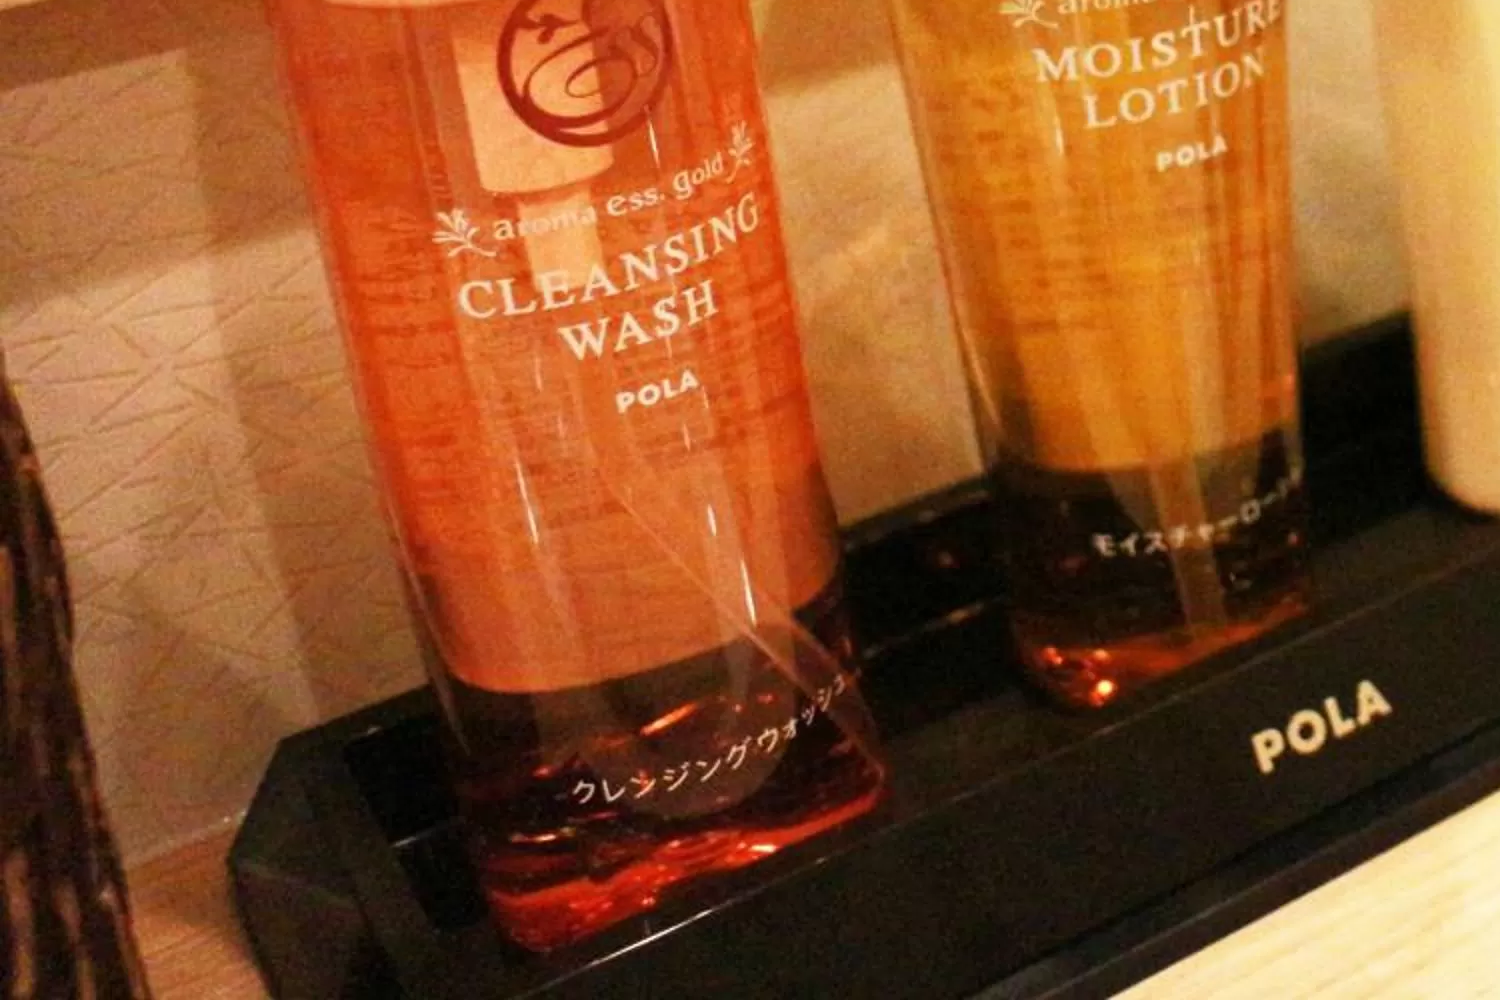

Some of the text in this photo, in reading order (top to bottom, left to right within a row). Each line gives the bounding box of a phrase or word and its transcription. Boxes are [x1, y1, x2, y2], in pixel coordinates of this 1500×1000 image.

[1082, 45, 1268, 129] LOTION
[1156, 134, 1228, 173] POLA
[493, 152, 724, 242] aroma ess. gold
[457, 191, 761, 320] CLEANSING
[557, 280, 719, 362] WASH
[615, 369, 700, 414] POLA
[1250, 679, 1393, 775] POLA
